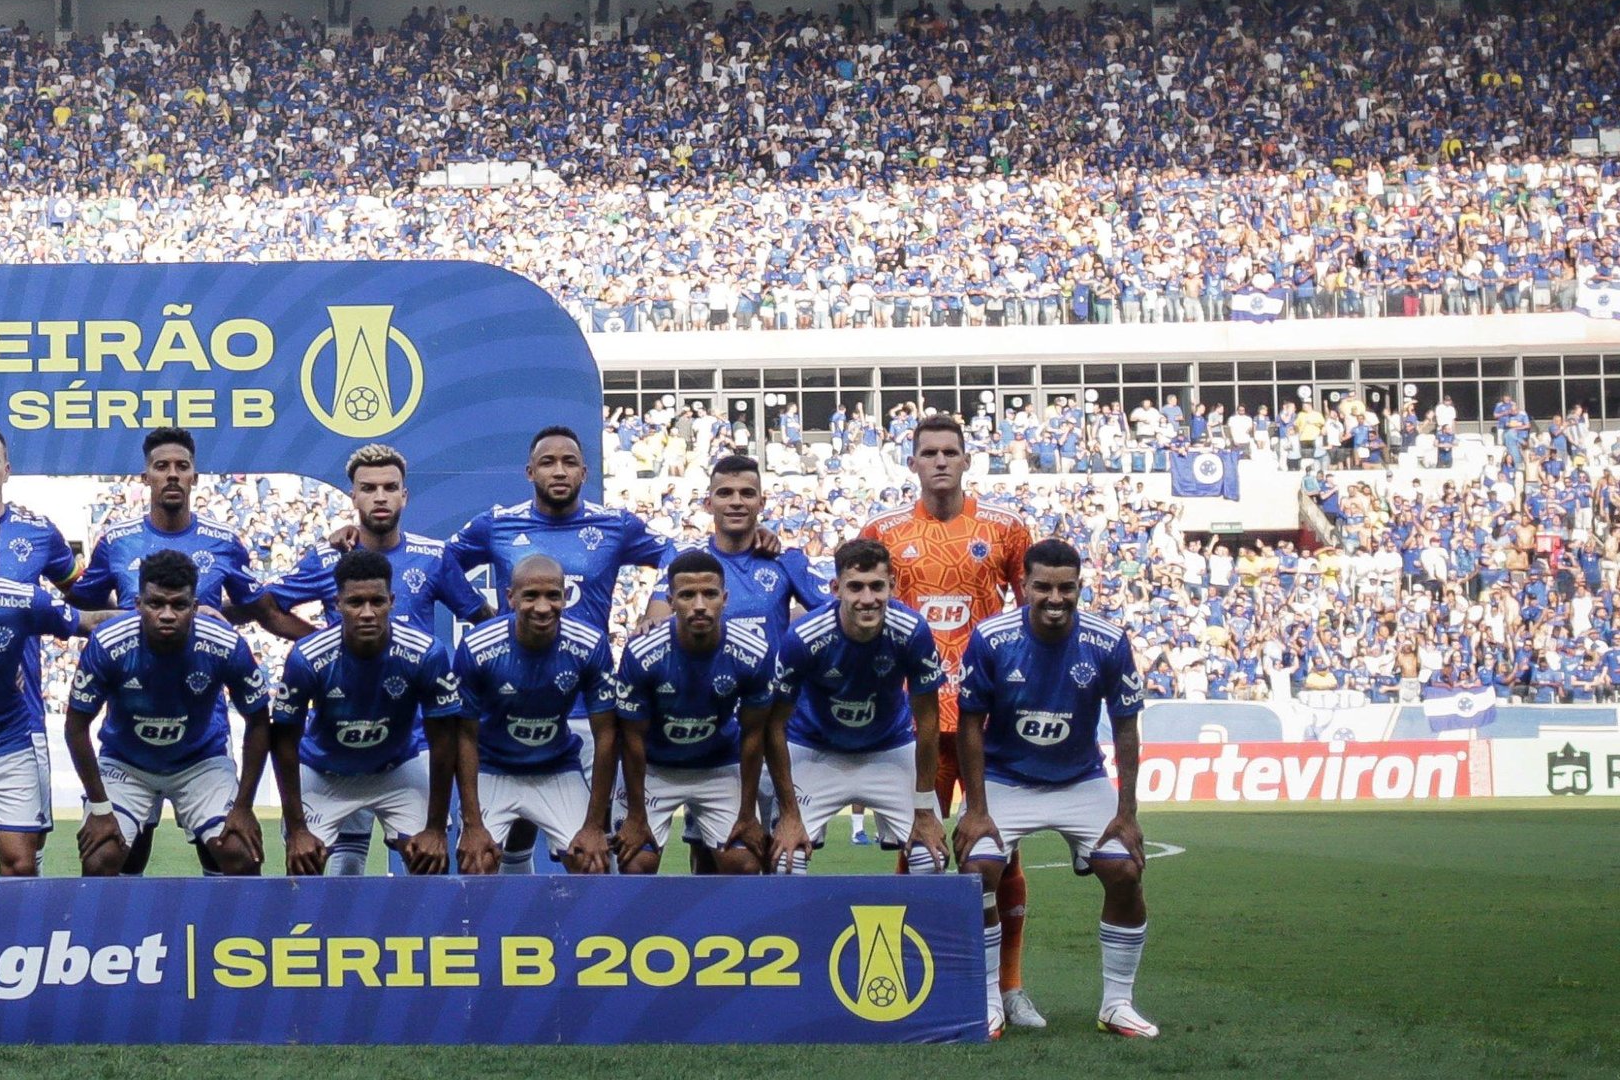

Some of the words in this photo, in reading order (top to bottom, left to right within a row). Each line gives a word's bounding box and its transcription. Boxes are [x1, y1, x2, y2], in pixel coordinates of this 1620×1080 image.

[8, 381, 214, 429] SÉRIE
[233, 390, 275, 428] B
[406, 545, 443, 560] pixbet
[927, 606, 963, 622] BH
[140, 725, 180, 740] BH
[342, 727, 381, 743] BH
[1022, 721, 1062, 738] BH
[212, 923, 481, 988] SÉRIE
[501, 936, 557, 987] B
[577, 934, 801, 987] 2022
